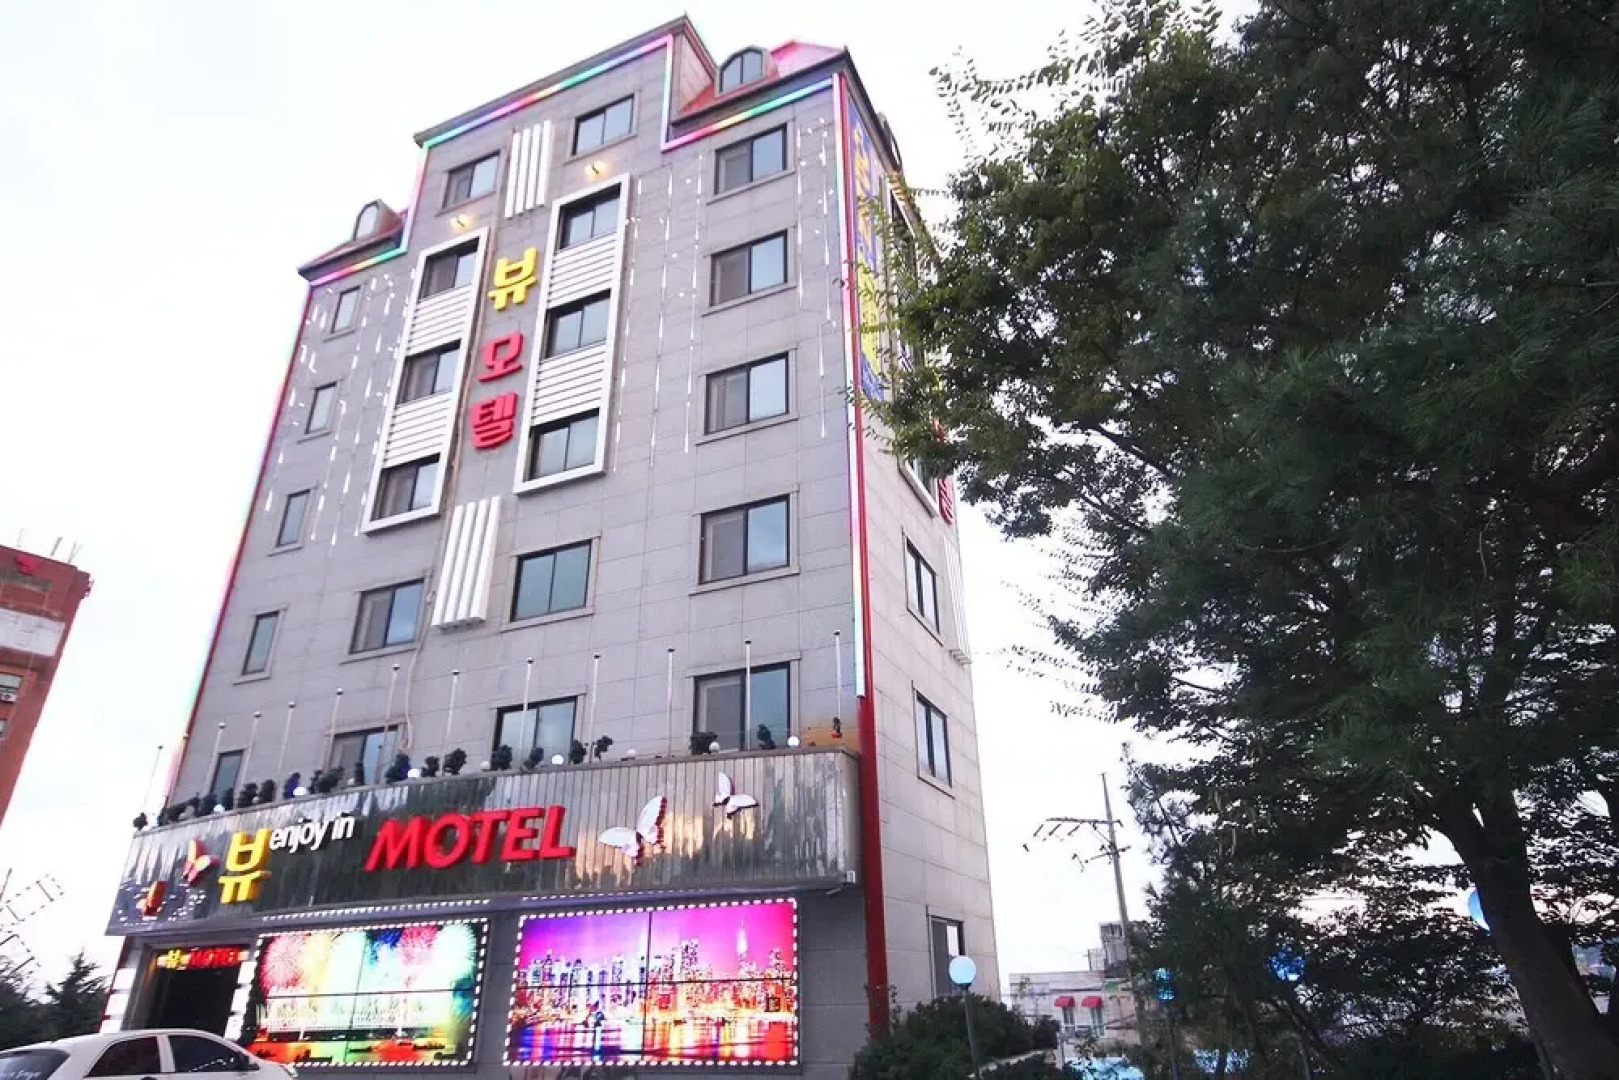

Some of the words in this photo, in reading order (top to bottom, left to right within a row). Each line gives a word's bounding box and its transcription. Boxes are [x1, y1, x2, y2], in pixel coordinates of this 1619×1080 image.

[488, 247, 538, 311] 뷰
[469, 332, 524, 449] 모텔
[269, 818, 330, 854] enjoy
[331, 812, 356, 841] in
[363, 805, 577, 872] MOTEL
